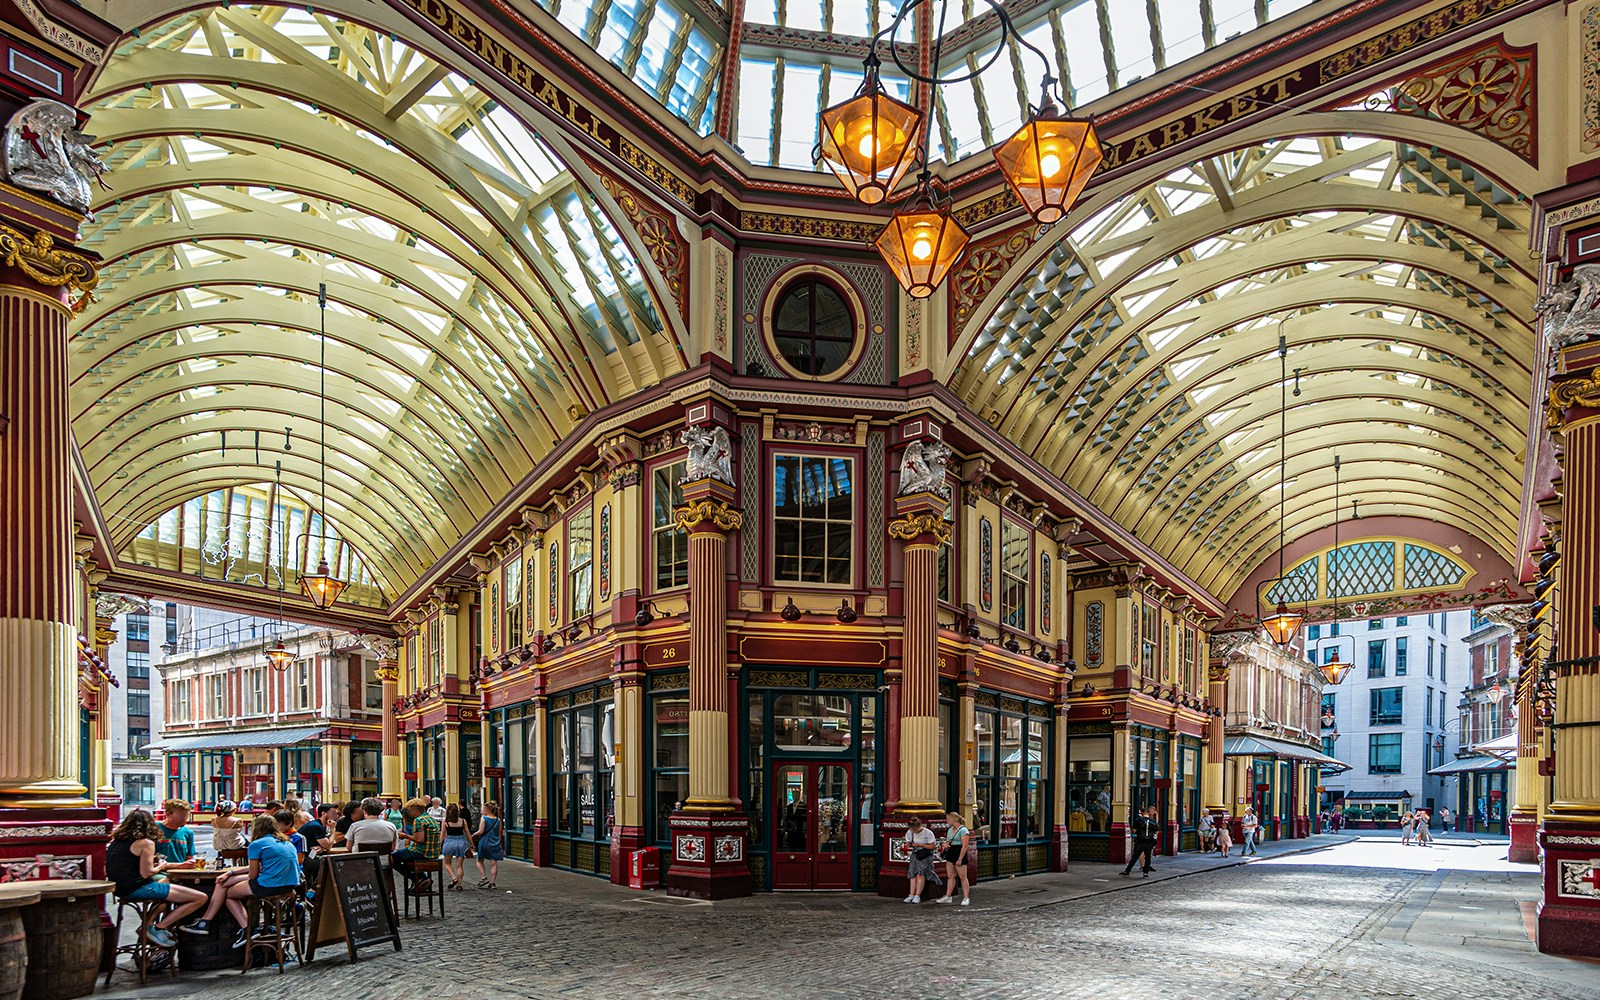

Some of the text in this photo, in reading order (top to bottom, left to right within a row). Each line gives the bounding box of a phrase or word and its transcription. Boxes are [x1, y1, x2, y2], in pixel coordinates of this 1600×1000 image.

[405, 0, 611, 149] DENHALL
[663, 648, 675, 659] 26
[581, 795, 595, 806] SALE
